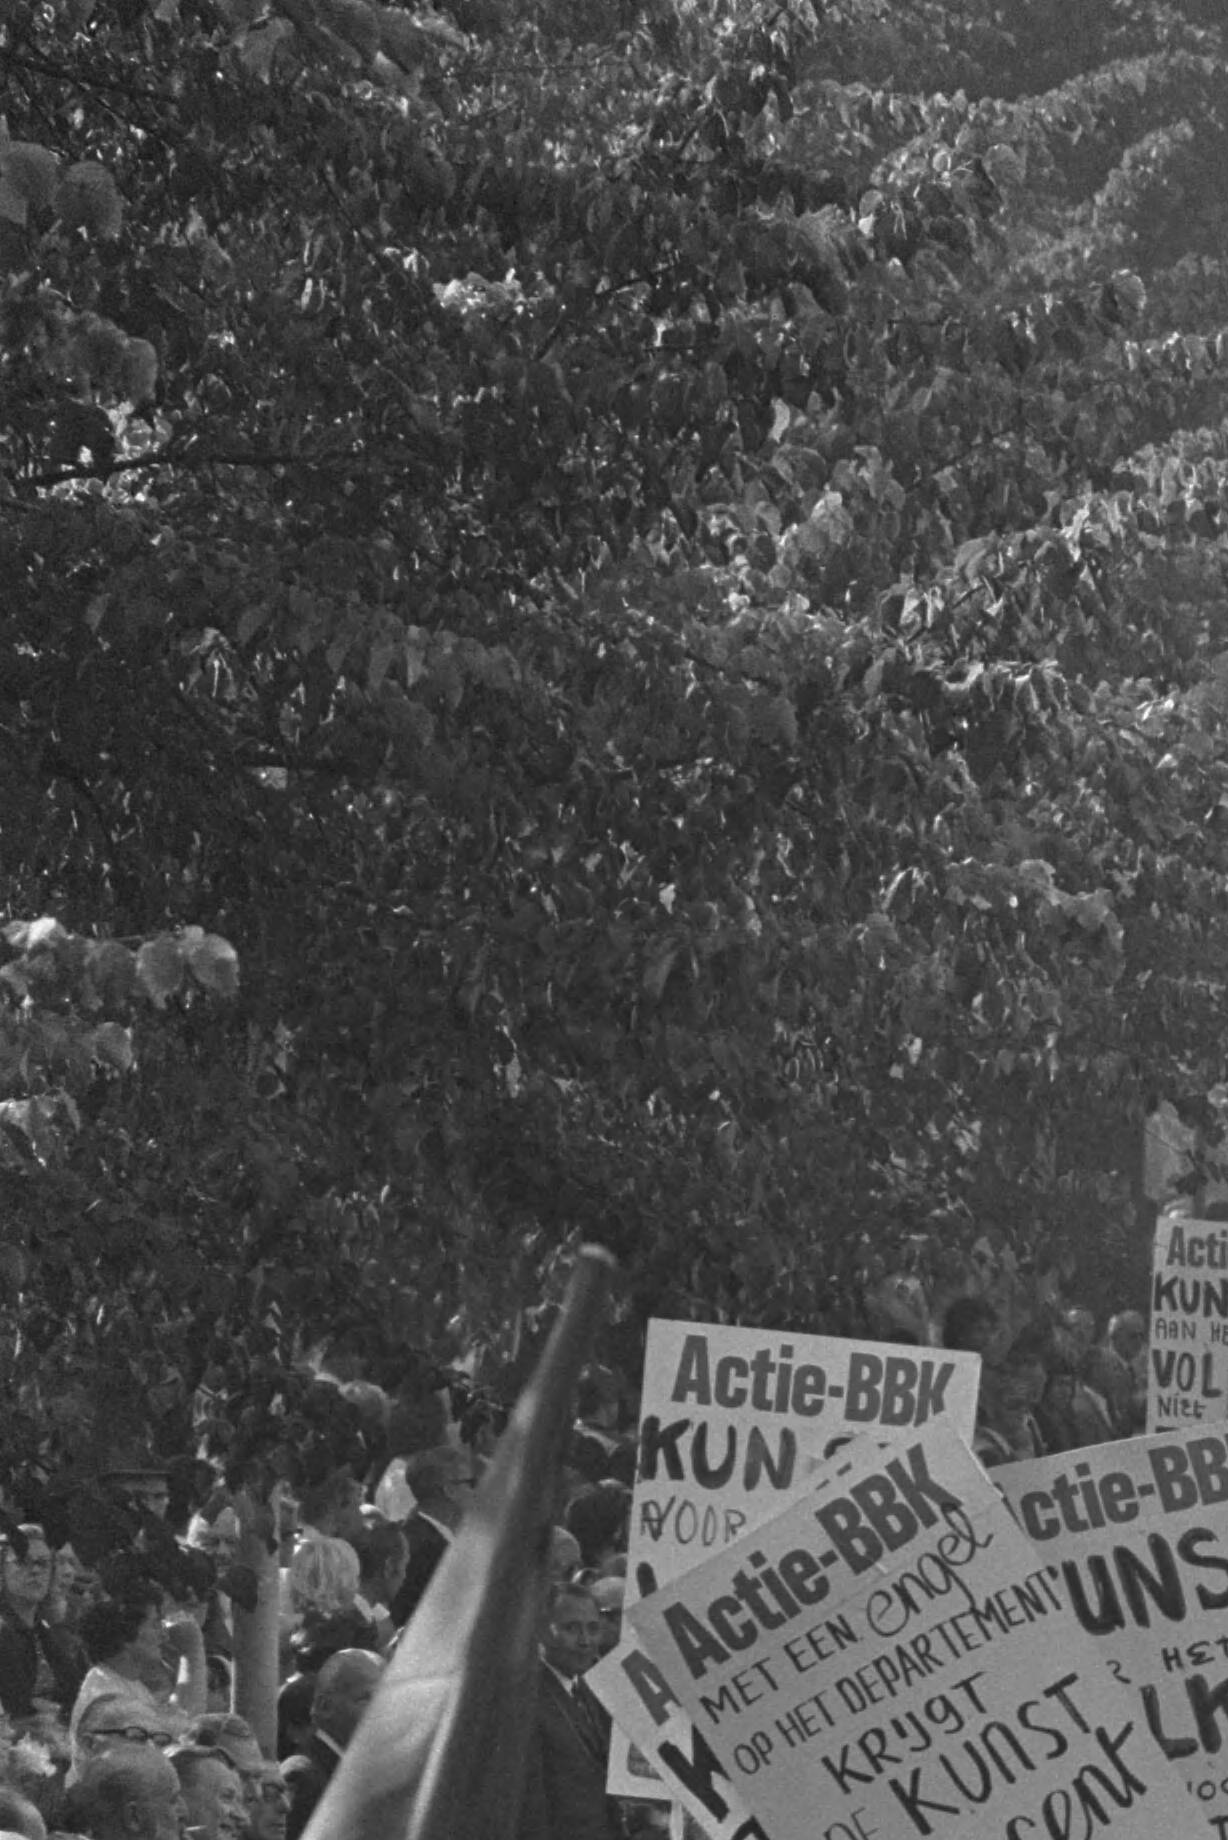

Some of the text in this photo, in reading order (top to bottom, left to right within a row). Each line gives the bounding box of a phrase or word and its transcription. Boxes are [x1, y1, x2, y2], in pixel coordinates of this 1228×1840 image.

[671, 1334, 955, 1428] Actie-BBK
[1155, 1318, 1196, 1340] AAN
[663, 1443, 964, 1680] Actie-BBK
[700, 1657, 779, 1724] MET
[783, 1613, 860, 1673] EEN
[866, 1501, 994, 1638] engel
[733, 1730, 775, 1775] OP
[775, 1690, 836, 1748] HET
[835, 1567, 1062, 1714] DEPARTEMENT
